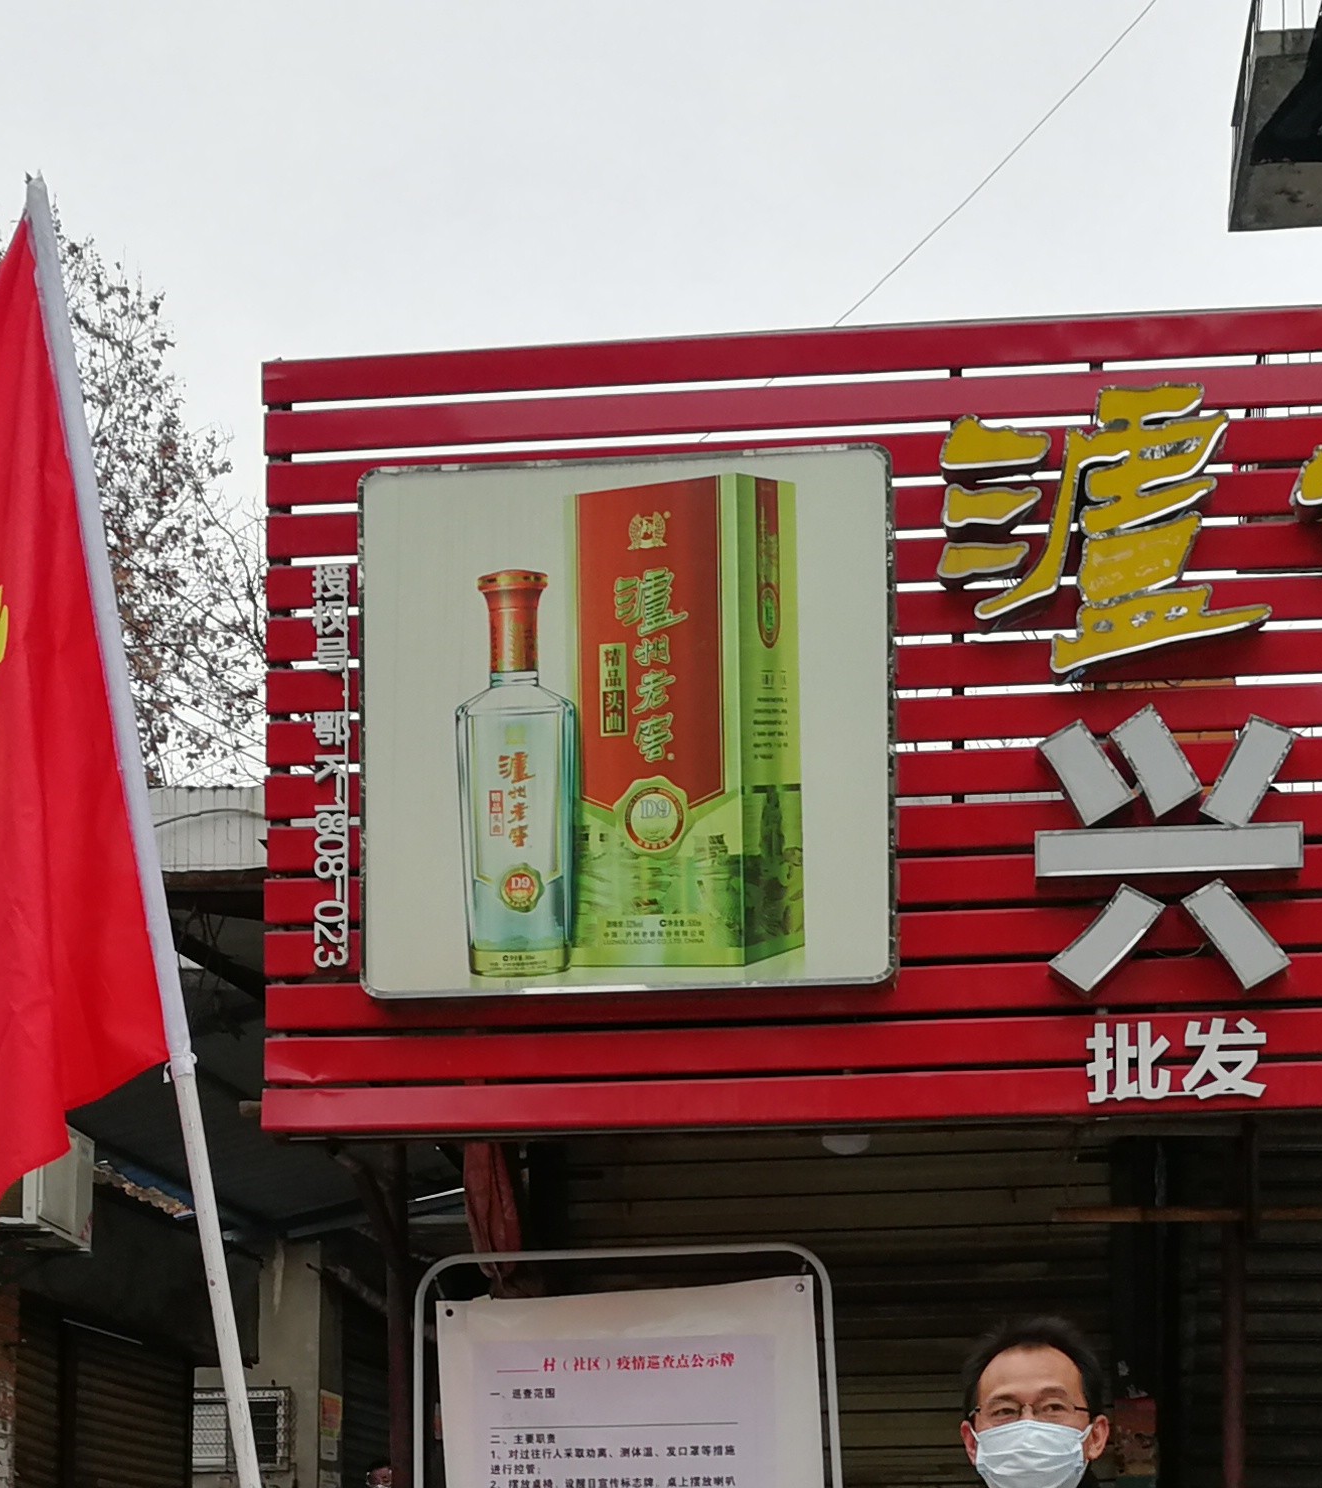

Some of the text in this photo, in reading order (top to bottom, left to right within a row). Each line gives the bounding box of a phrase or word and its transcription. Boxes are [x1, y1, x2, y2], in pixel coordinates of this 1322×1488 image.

[641, 801, 672, 819] D9
[511, 877, 531, 888] D9
[1085, 1018, 1269, 1104] 批发
